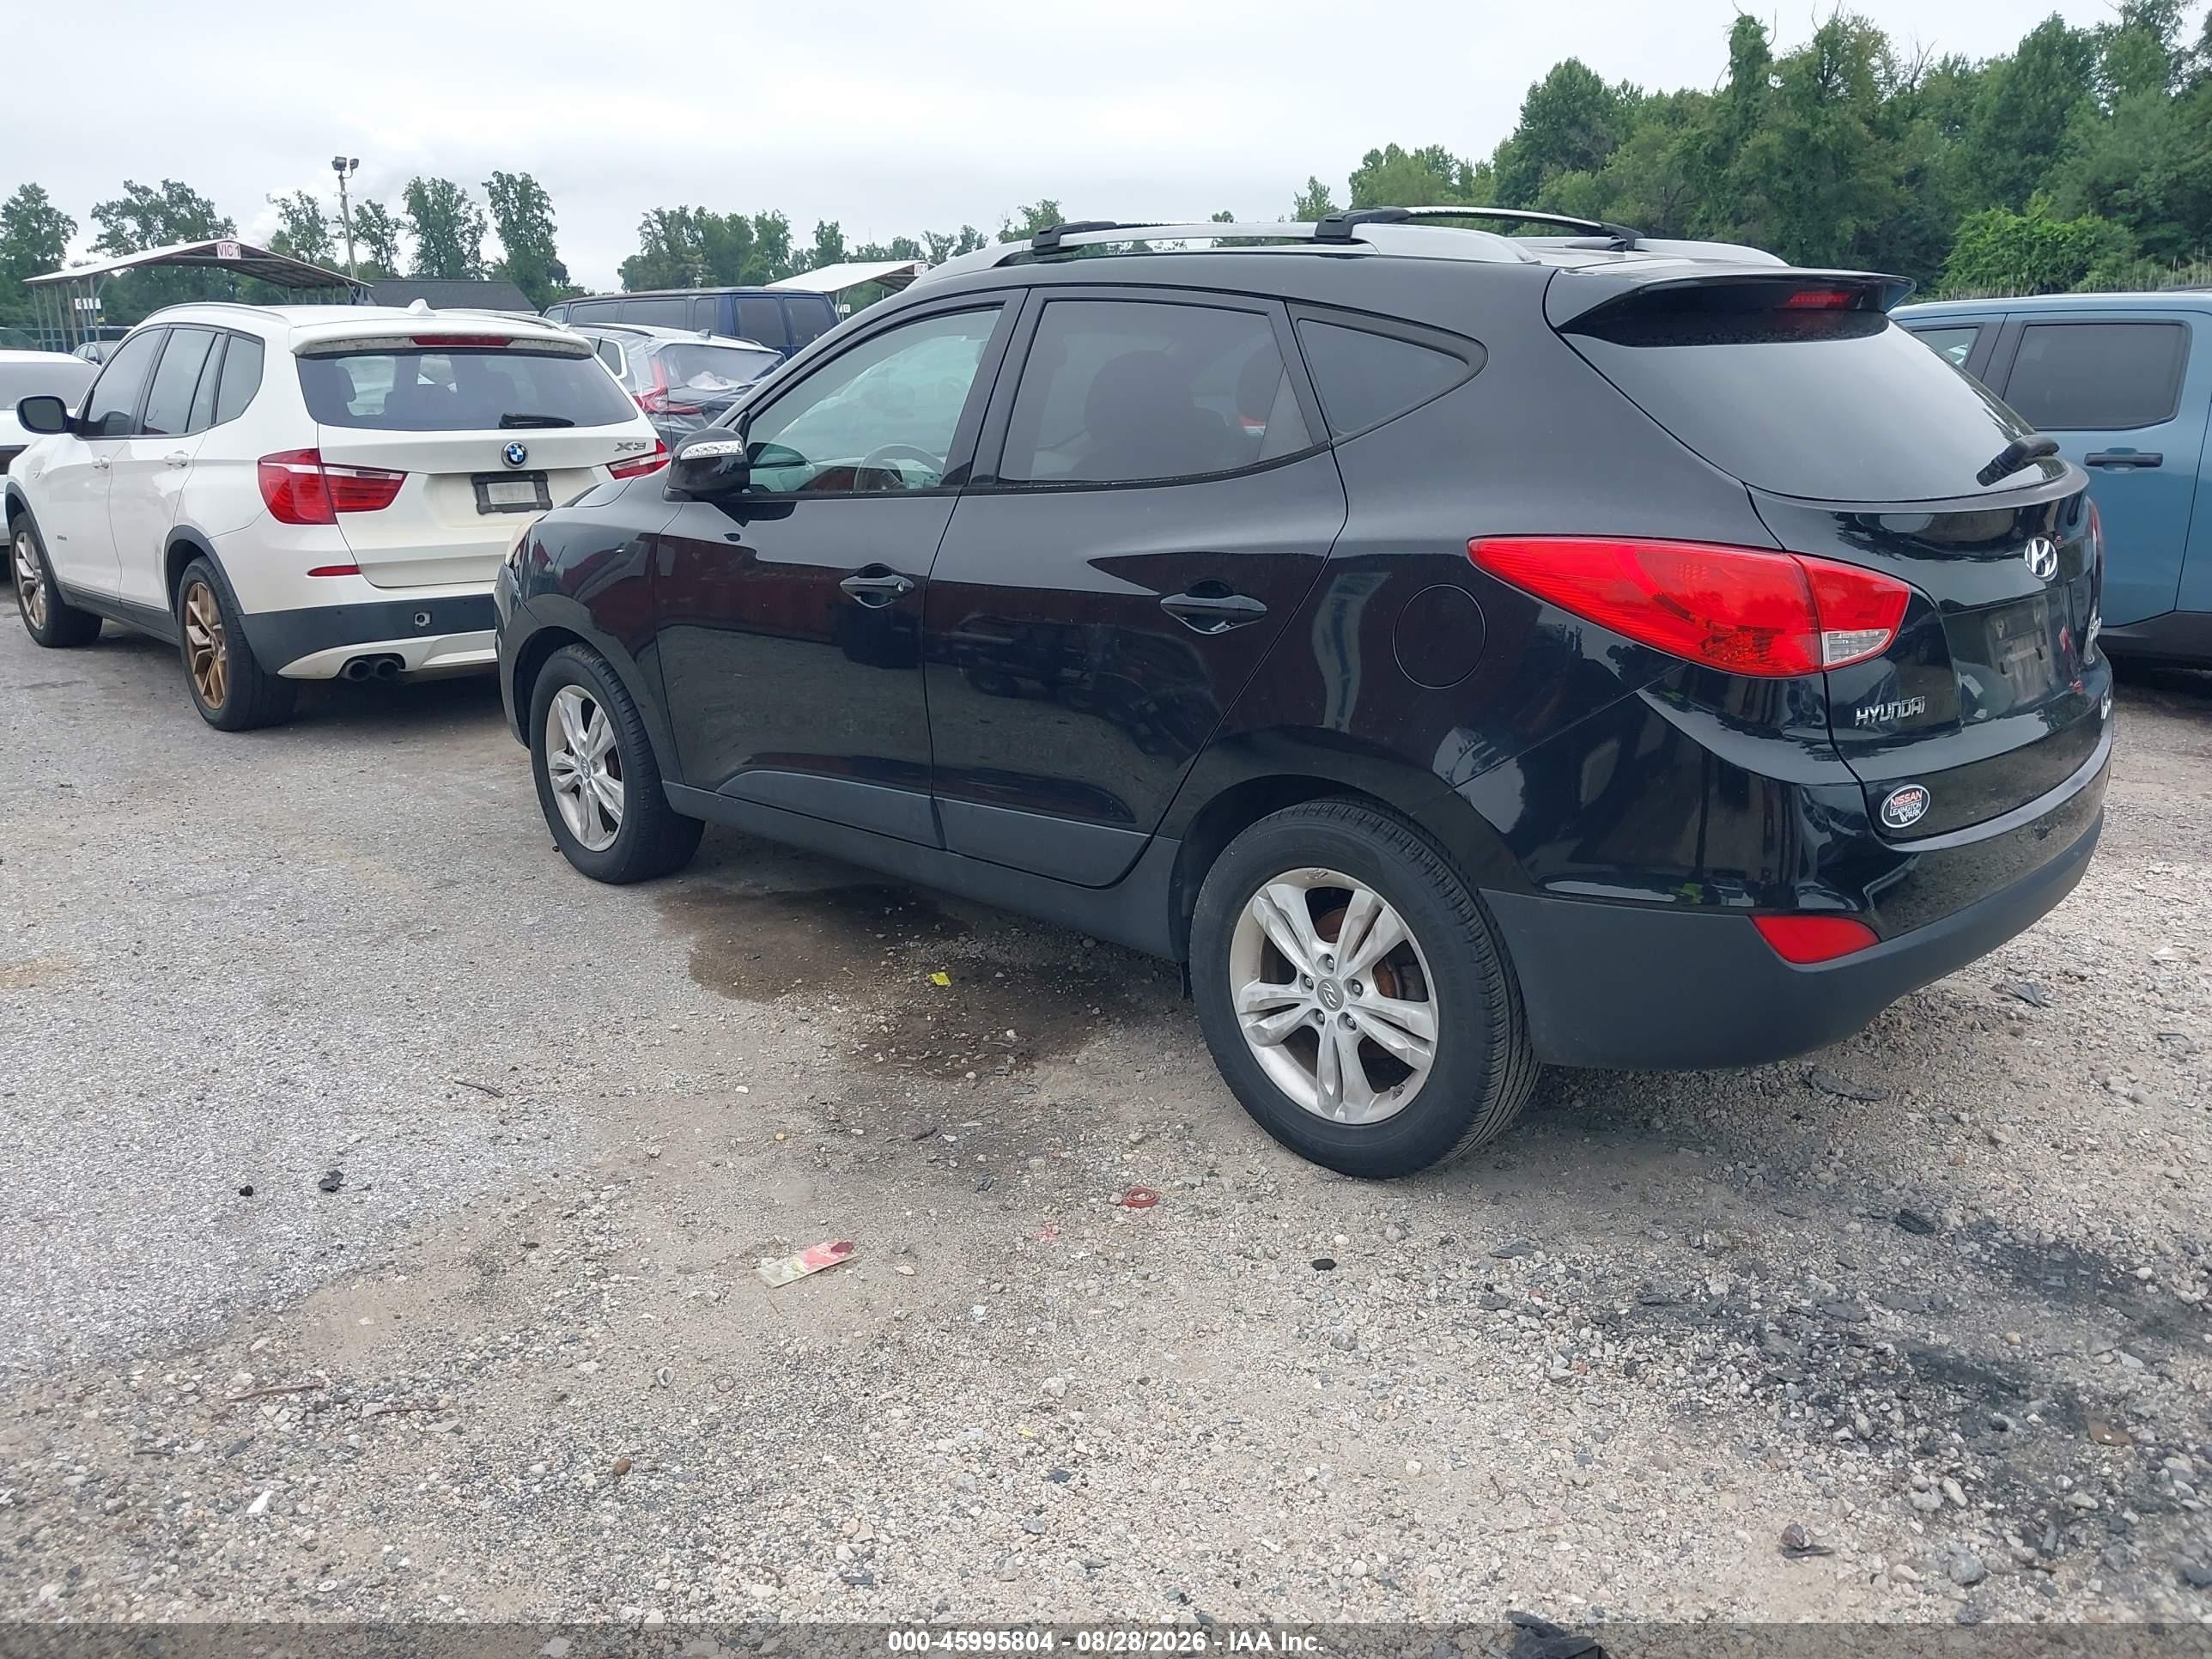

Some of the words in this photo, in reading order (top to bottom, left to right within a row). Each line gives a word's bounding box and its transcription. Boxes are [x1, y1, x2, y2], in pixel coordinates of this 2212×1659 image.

[218, 244, 233, 257] VIC
[235, 245, 240, 257] 1
[614, 441, 646, 452] X3
[1855, 696, 1925, 726] HYUNDAI
[1890, 790, 1923, 808] NISSAN
[1890, 801, 1922, 819] LEXINGTON
